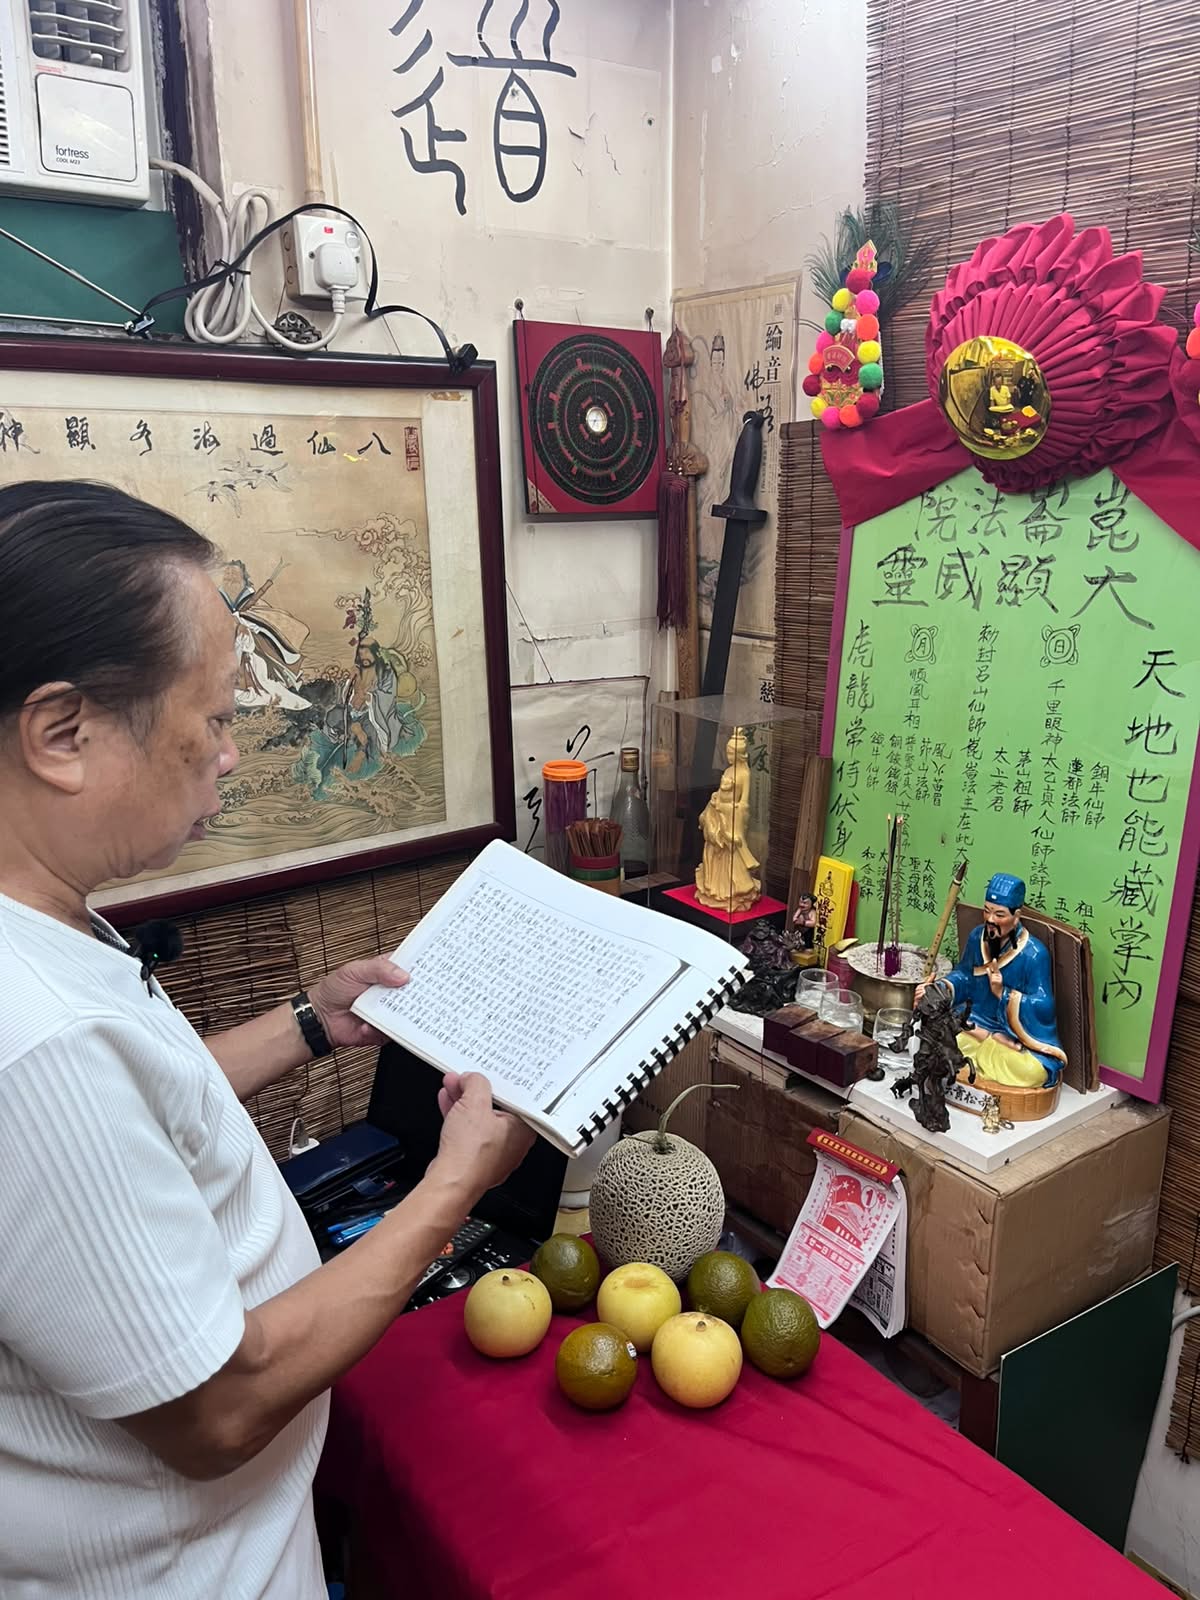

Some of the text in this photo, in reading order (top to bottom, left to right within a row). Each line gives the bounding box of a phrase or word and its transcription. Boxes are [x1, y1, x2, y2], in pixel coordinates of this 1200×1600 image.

[56, 145, 89, 159] fortress
[872, 542, 1155, 630] 大顯威靈
[987, 747, 1011, 813] 太上老君
